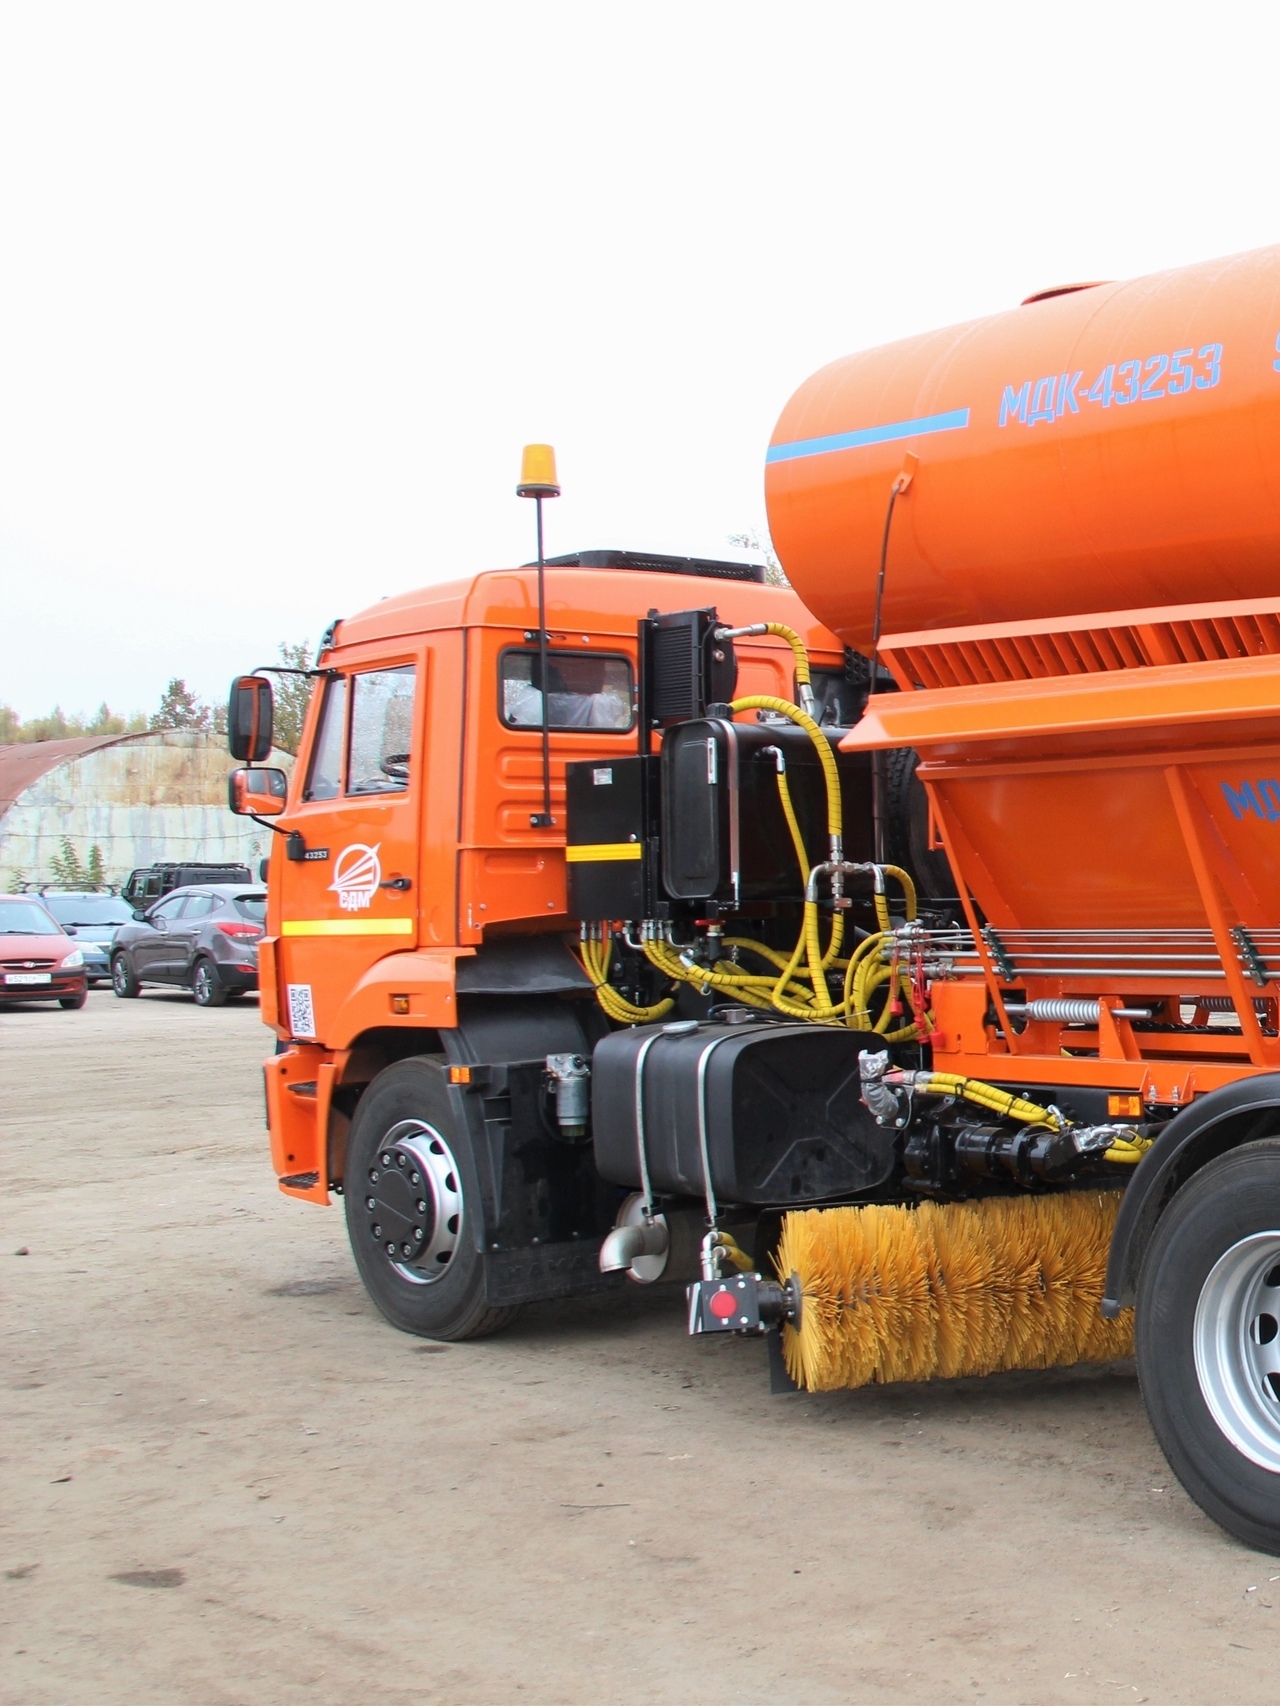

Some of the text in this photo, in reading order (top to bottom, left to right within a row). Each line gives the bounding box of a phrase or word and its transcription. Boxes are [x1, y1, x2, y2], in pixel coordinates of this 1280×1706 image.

[998, 343, 1223, 427] МДК-43253
[304, 850, 327, 859] 43253
[339, 890, 371, 911] СДМ
